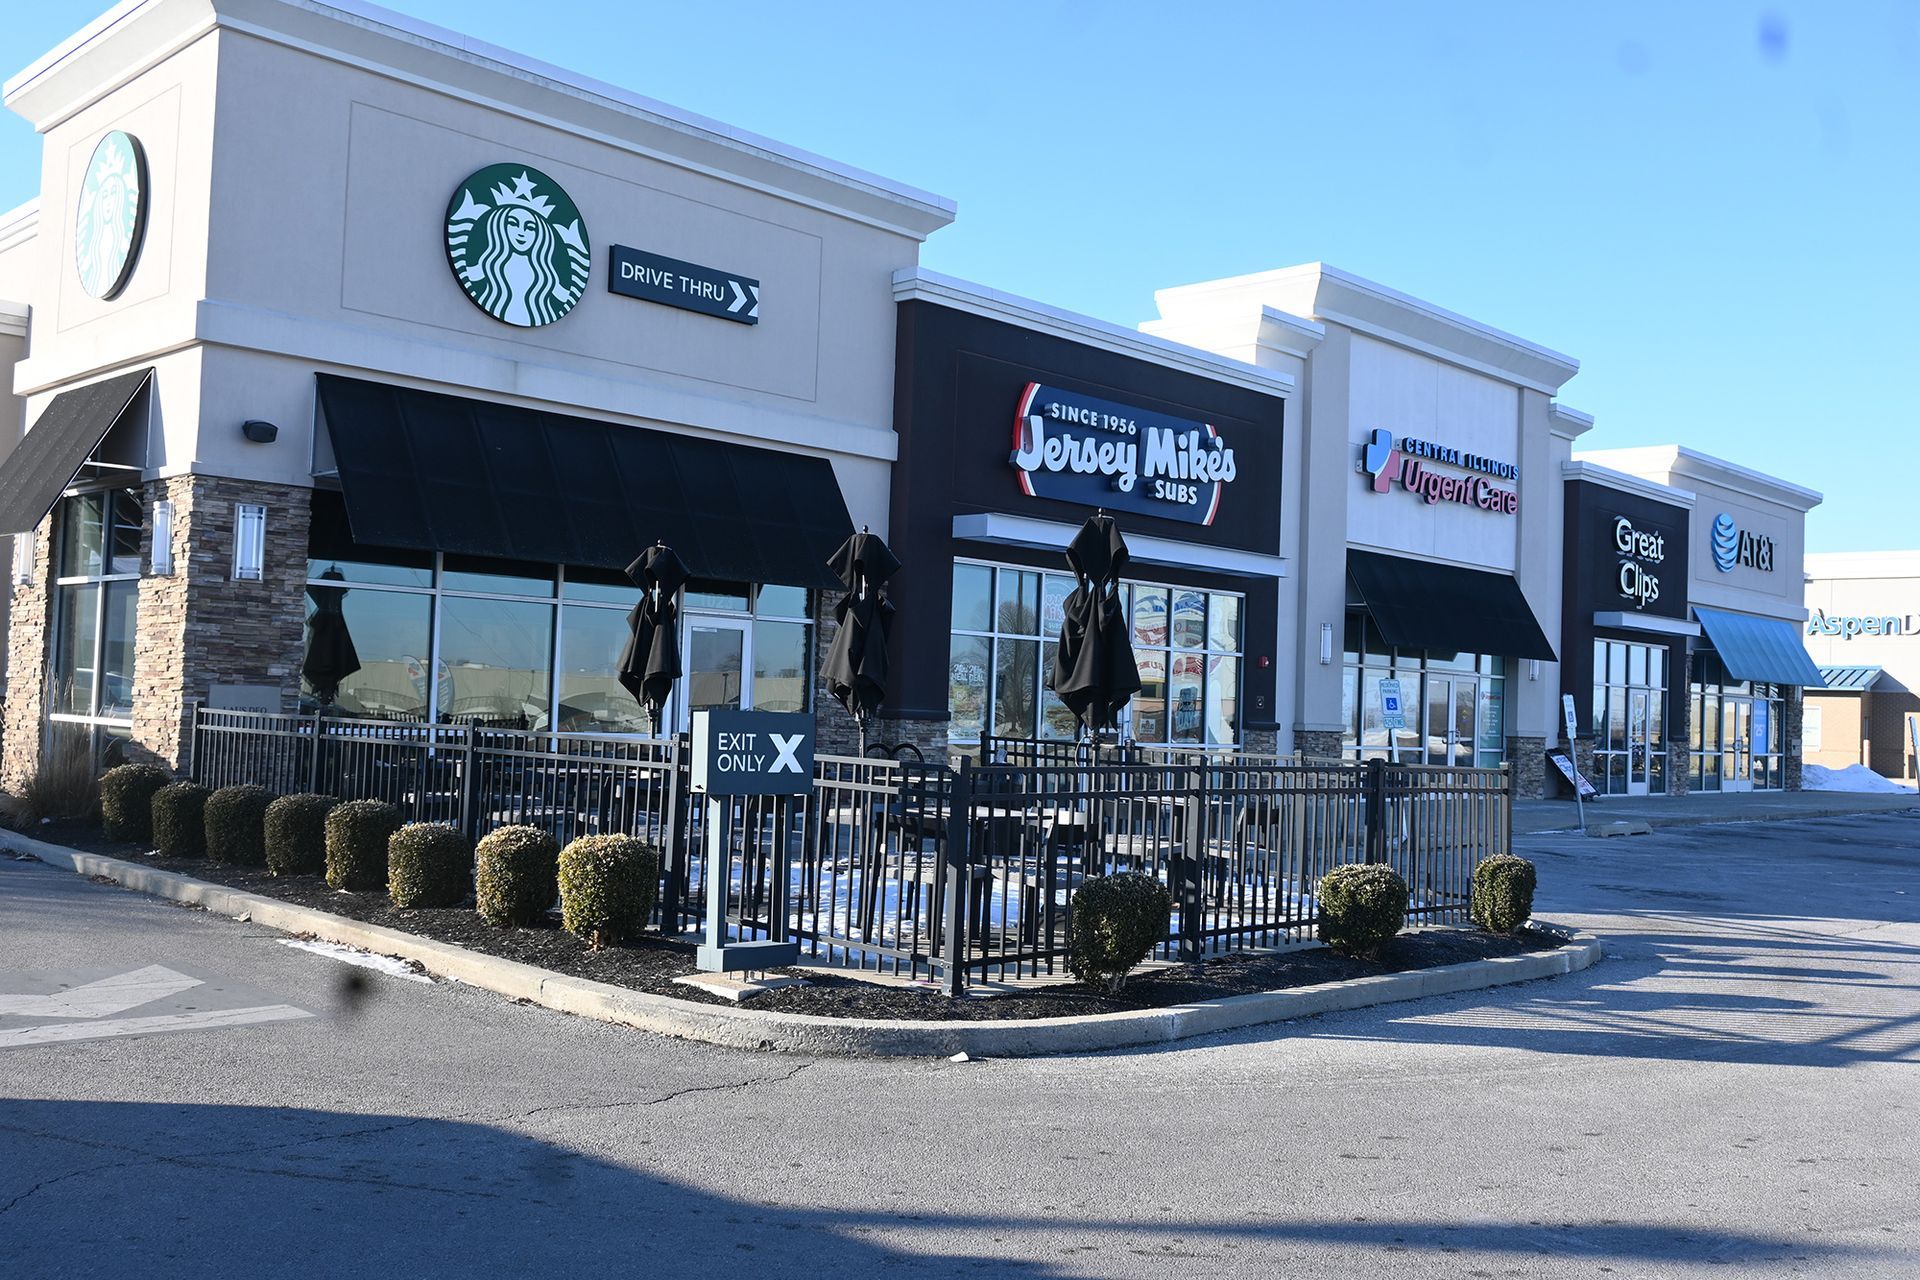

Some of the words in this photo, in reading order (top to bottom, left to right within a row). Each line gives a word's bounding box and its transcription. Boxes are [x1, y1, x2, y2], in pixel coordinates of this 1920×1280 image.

[621, 261, 673, 290] DRIVE
[679, 275, 724, 302] THRU
[1051, 402, 1098, 426] SINCE
[1103, 414, 1137, 436] 1956
[1015, 414, 1137, 492] Jersey
[1143, 427, 1237, 484] Mike's
[1404, 437, 1465, 467] CENTRAL
[1466, 453, 1519, 481] ILLINOIS
[1154, 479, 1197, 505] SUBS
[1403, 459, 1473, 505] Urgent
[1475, 477, 1518, 515] Care
[1615, 517, 1665, 561] Great
[1738, 529, 1777, 572] AT&T
[1619, 563, 1660, 607] Clips
[717, 753, 766, 772] ONLY
[718, 732, 757, 751] EXIT
